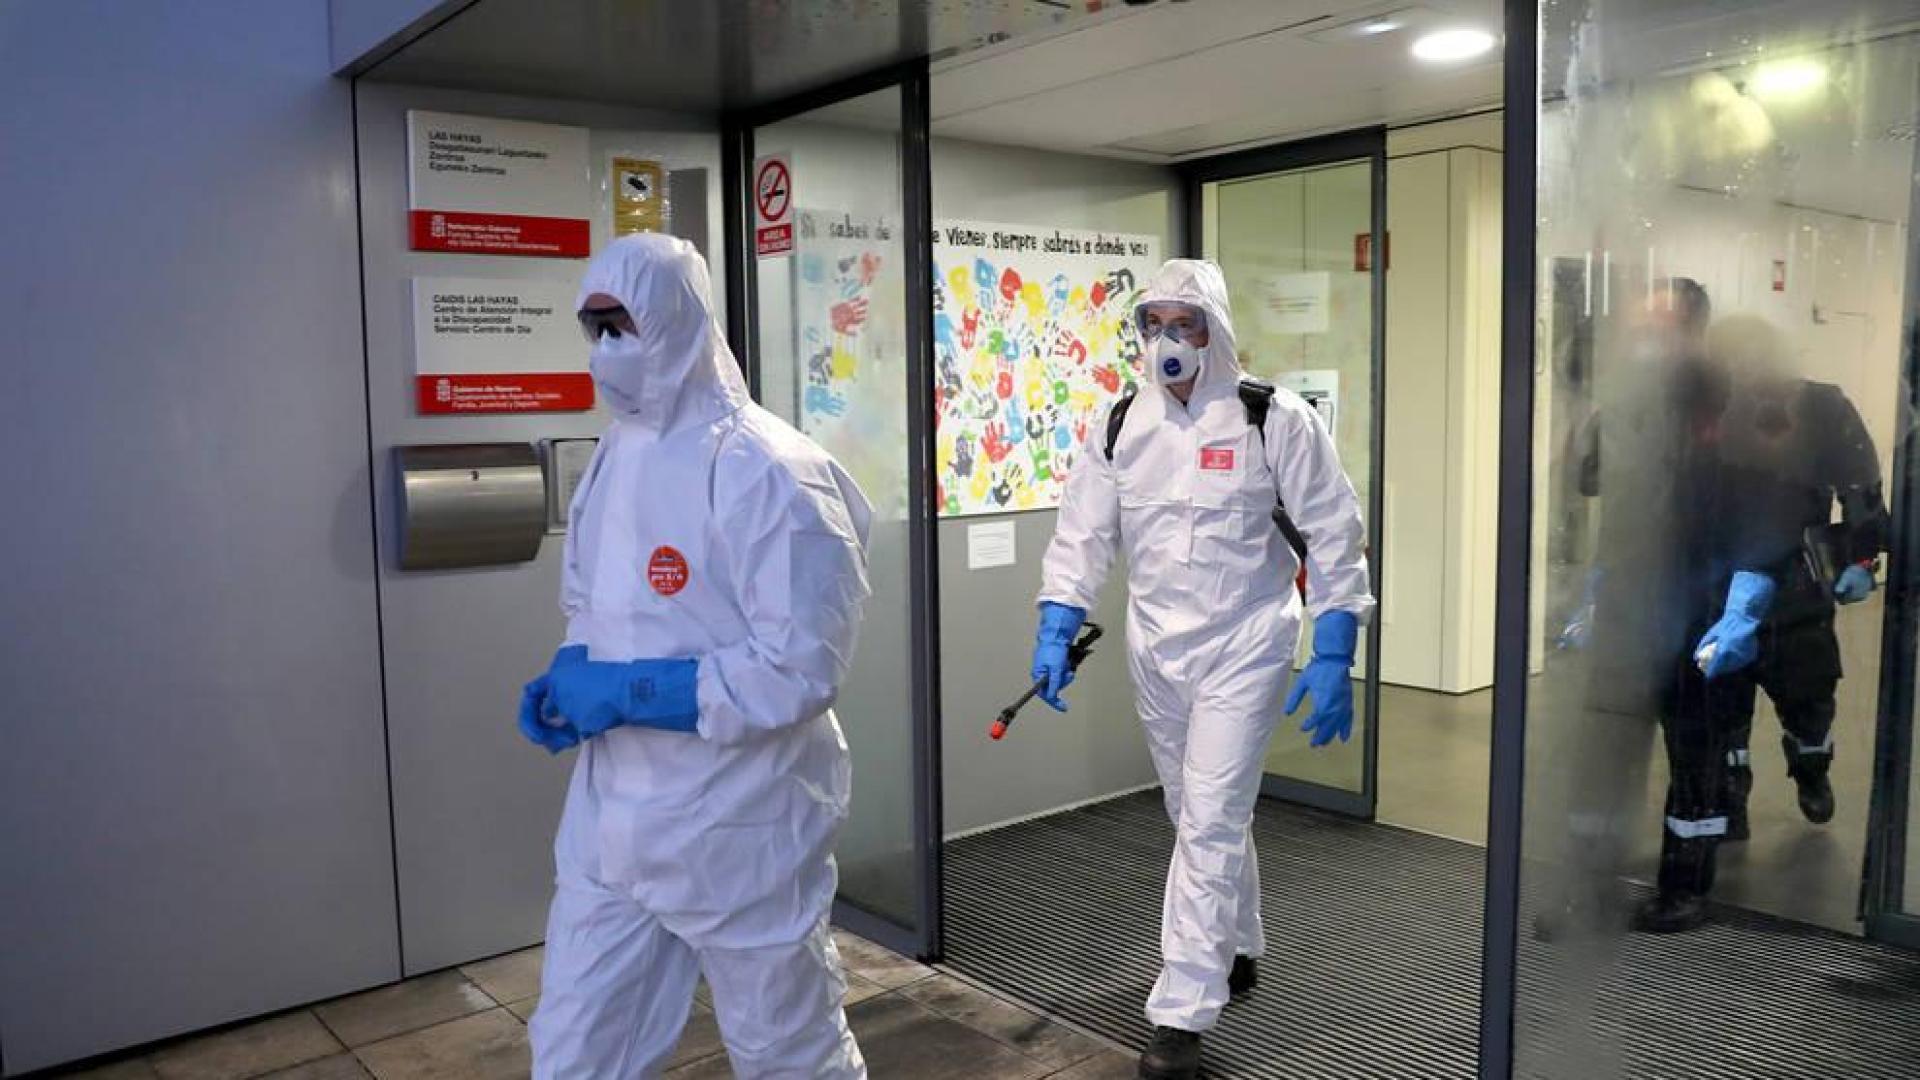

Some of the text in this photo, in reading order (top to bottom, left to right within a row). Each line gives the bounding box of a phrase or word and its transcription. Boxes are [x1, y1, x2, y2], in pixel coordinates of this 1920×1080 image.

[467, 295, 486, 304] LAS
[487, 296, 519, 305] HAYAS
[433, 304, 465, 313] Centro
[467, 305, 478, 313] de
